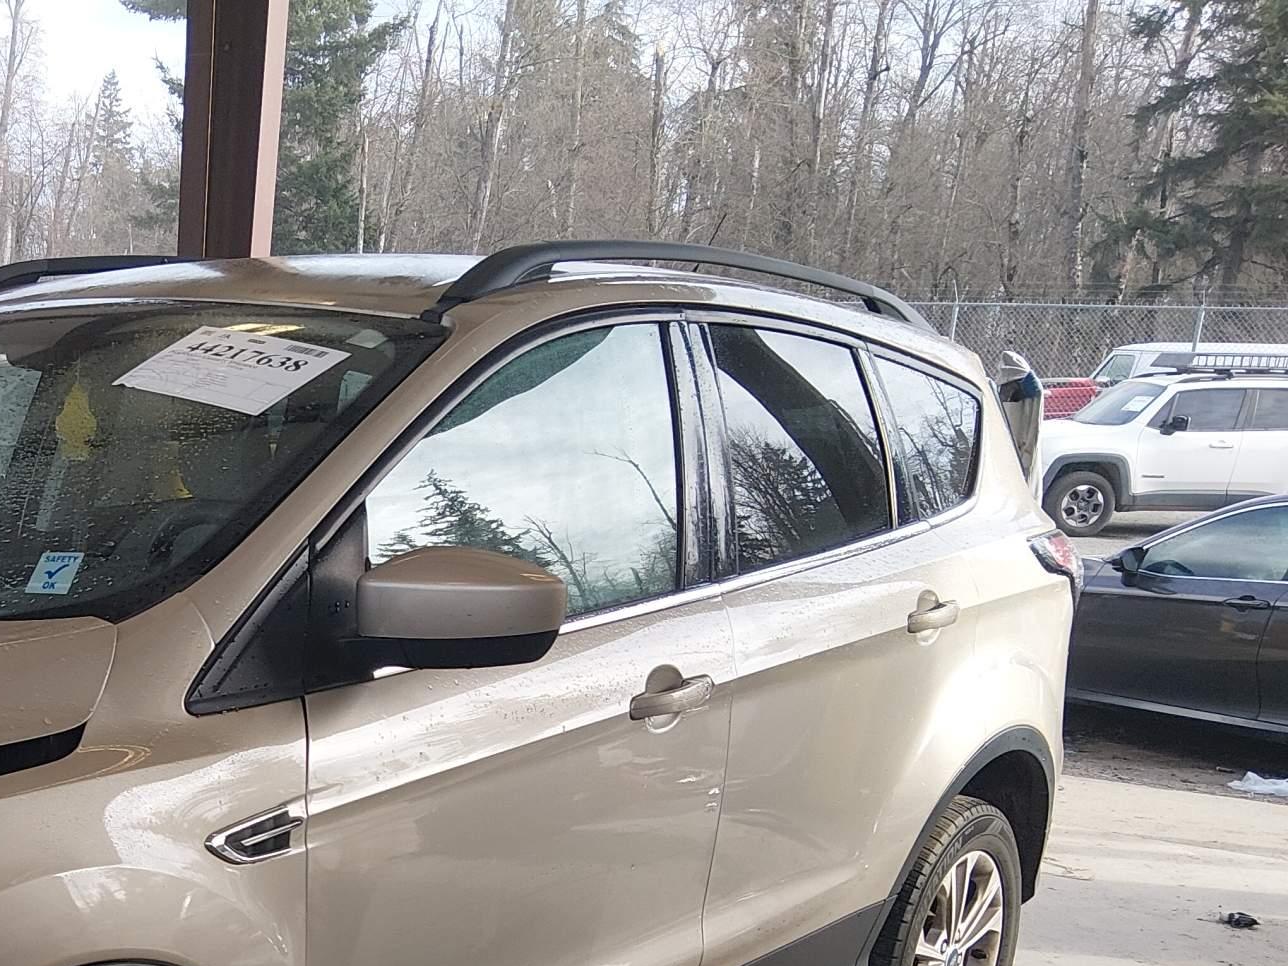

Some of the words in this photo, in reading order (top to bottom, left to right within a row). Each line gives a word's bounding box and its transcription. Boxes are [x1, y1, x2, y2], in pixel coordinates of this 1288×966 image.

[187, 341, 309, 372] 44217638
[44, 555, 79, 563] SAFETY
[42, 581, 57, 590] OK
